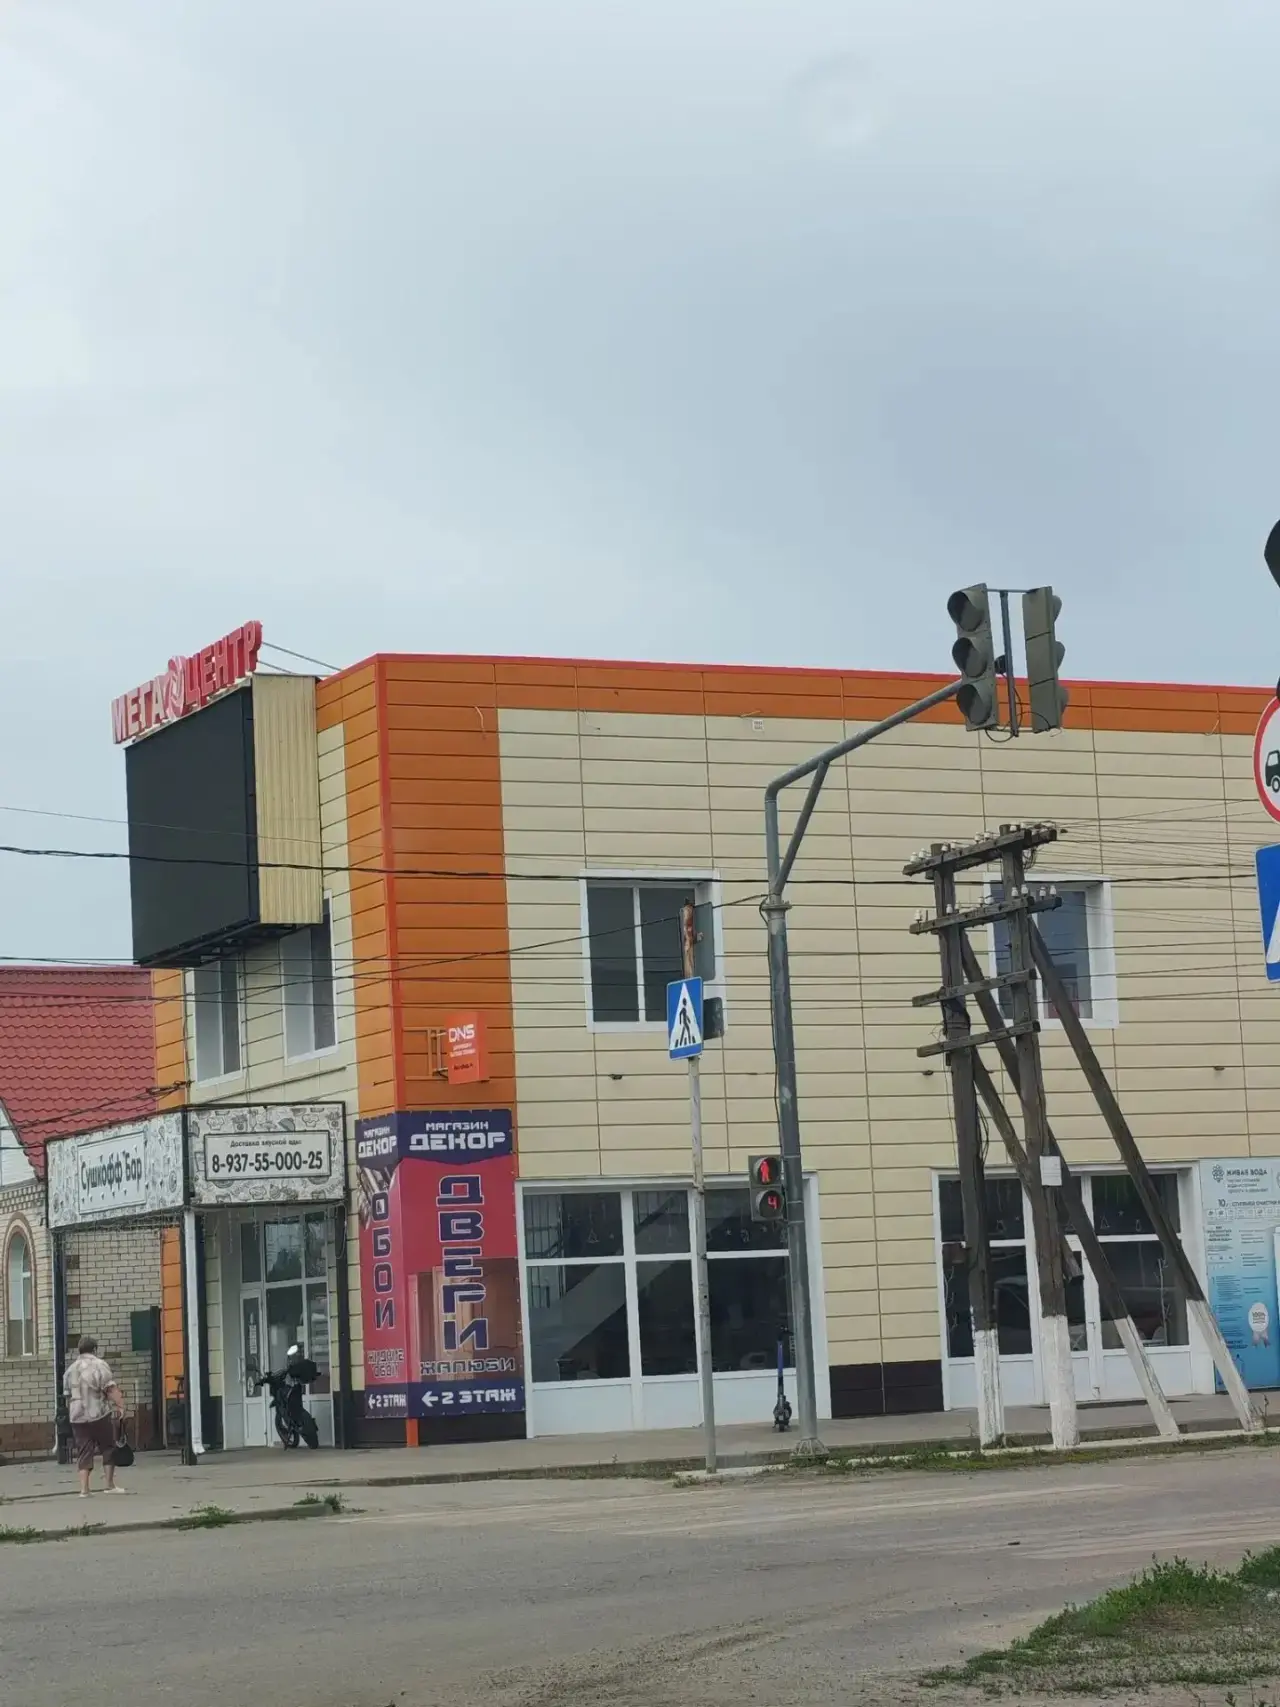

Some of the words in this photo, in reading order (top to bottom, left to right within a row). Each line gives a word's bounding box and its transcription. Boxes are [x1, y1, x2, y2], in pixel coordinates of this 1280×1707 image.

[111, 674, 167, 744] МЕГА
[184, 620, 263, 707] ЦЕНТР
[448, 1023, 475, 1043] DNS
[363, 1126, 390, 1138] МАГАЗИН
[425, 1121, 489, 1131] МАГАЗИН
[358, 1135, 397, 1159] ДЕКОР
[409, 1132, 506, 1150] ДЕКОР
[80, 1155, 123, 1191] Сушкофф
[124, 1155, 143, 1188] Бар
[212, 1150, 323, 1174] 8-937-55-000-25
[371, 1190, 395, 1331] ОБОИ
[436, 1175, 489, 1350] ДВЕРИ
[376, 1395, 382, 1408] 2
[383, 1394, 407, 1408] ЭТАЖ
[441, 1392, 454, 1404] 2
[459, 1388, 516, 1404] ЭТАЖ
